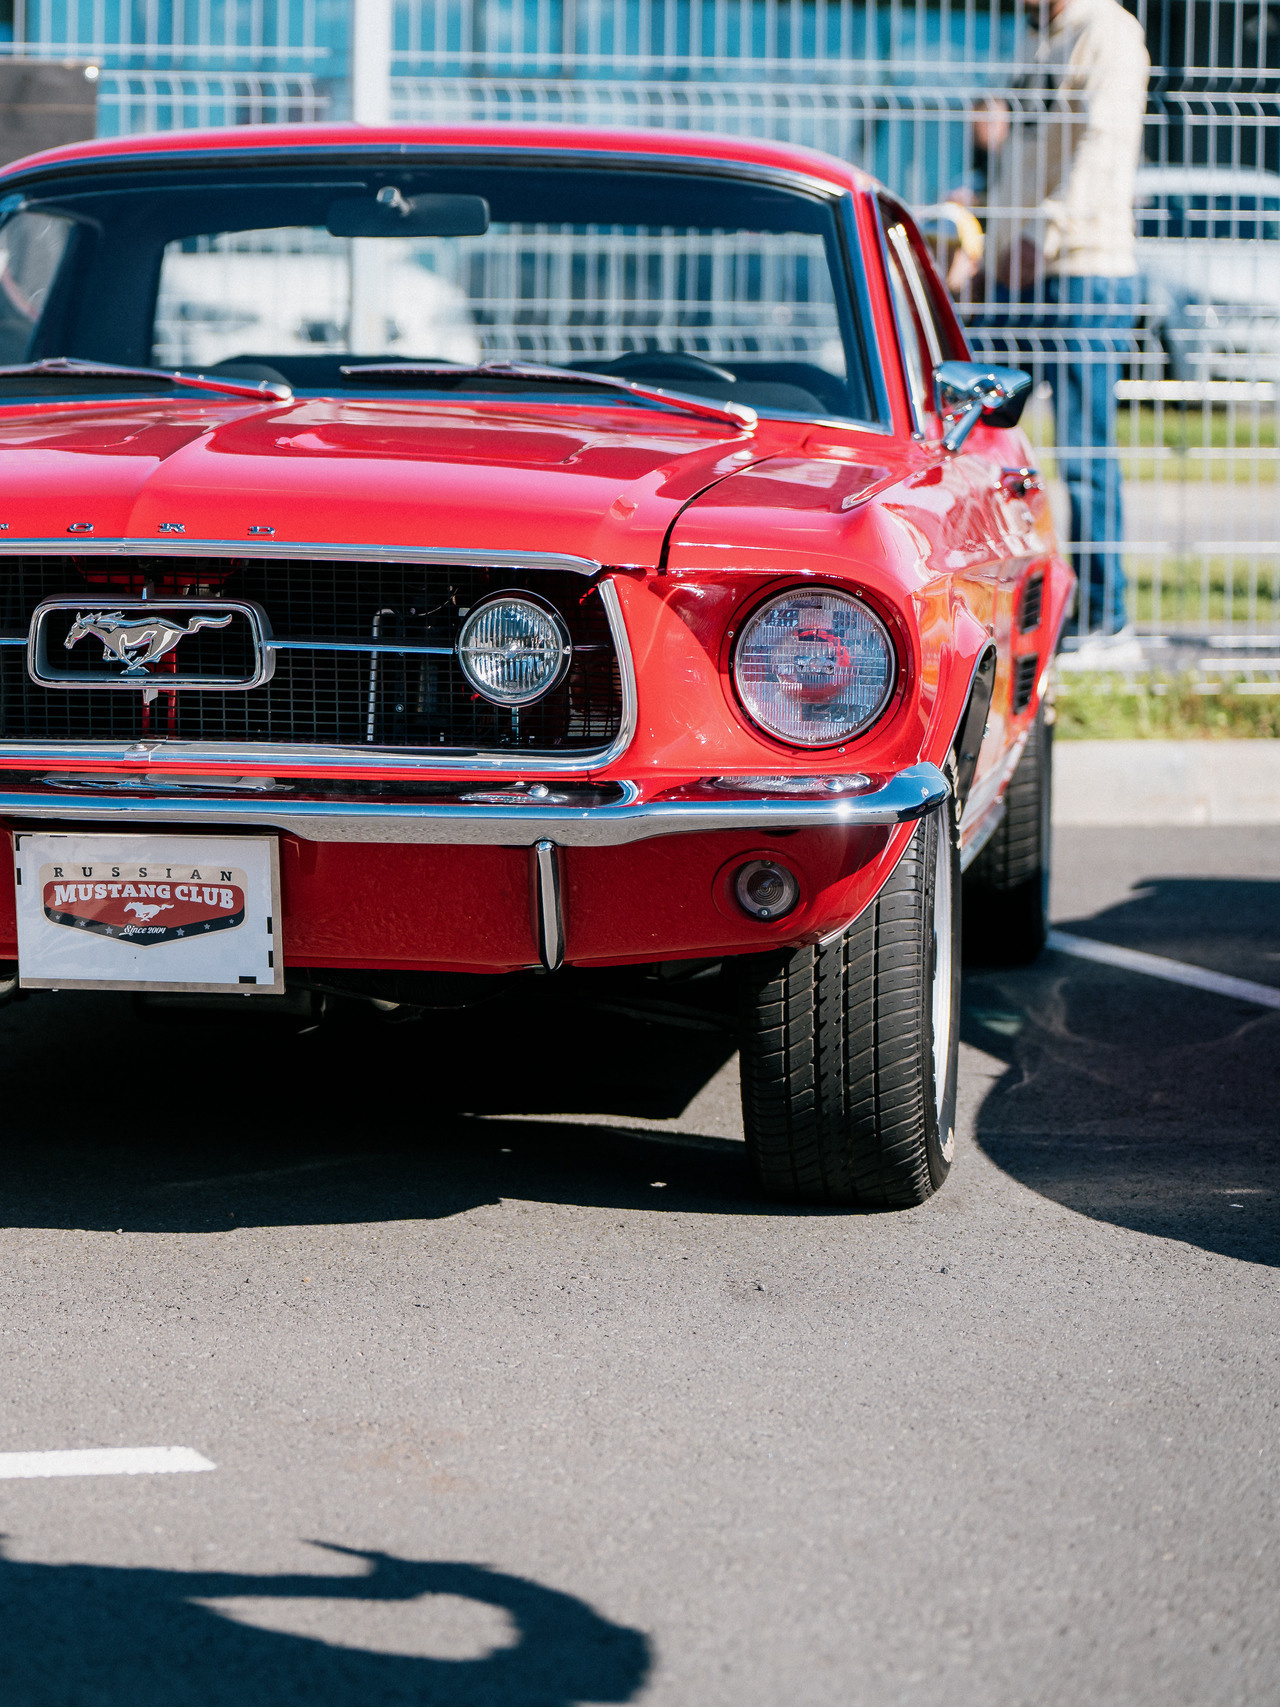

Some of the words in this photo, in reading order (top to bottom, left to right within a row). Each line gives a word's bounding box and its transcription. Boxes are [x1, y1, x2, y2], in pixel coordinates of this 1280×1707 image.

[53, 866, 233, 882] RUSSIAN
[54, 884, 170, 906] MUSTANG
[175, 885, 234, 909] CLUB
[119, 924, 147, 936] Since
